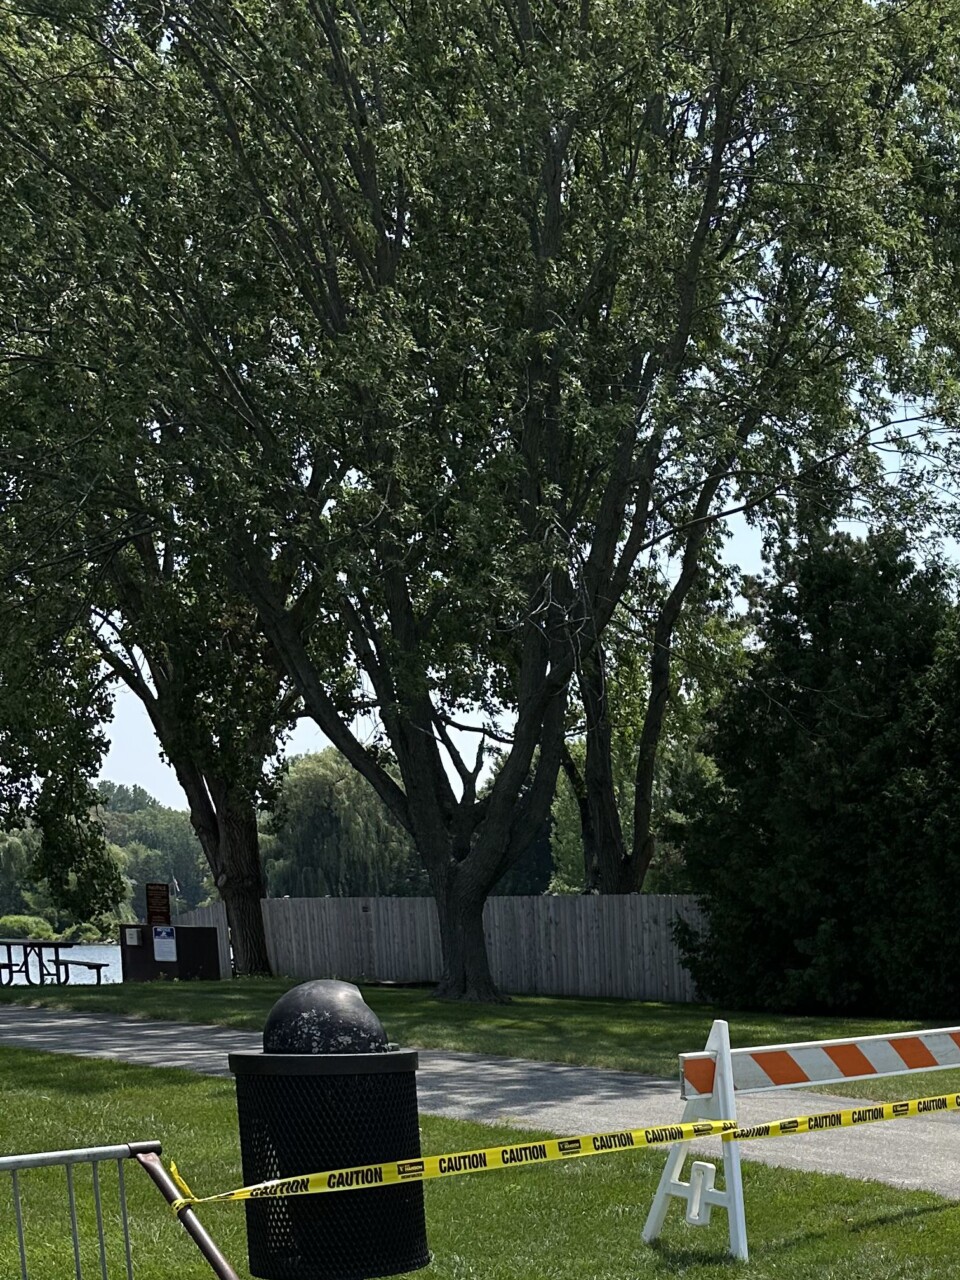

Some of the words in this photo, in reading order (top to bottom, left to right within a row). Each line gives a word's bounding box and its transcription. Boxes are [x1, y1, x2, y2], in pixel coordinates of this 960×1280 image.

[808, 1113, 842, 1130] CAUTION
[852, 1107, 884, 1123] CAUTION
[917, 1097, 947, 1112] CAUTION
[327, 1167, 383, 1188] CAUTION
[439, 1152, 487, 1173] CAUTION
[502, 1144, 547, 1164] CAUTION
[592, 1132, 634, 1151] CAUTION
[645, 1127, 684, 1144] CAUTION
